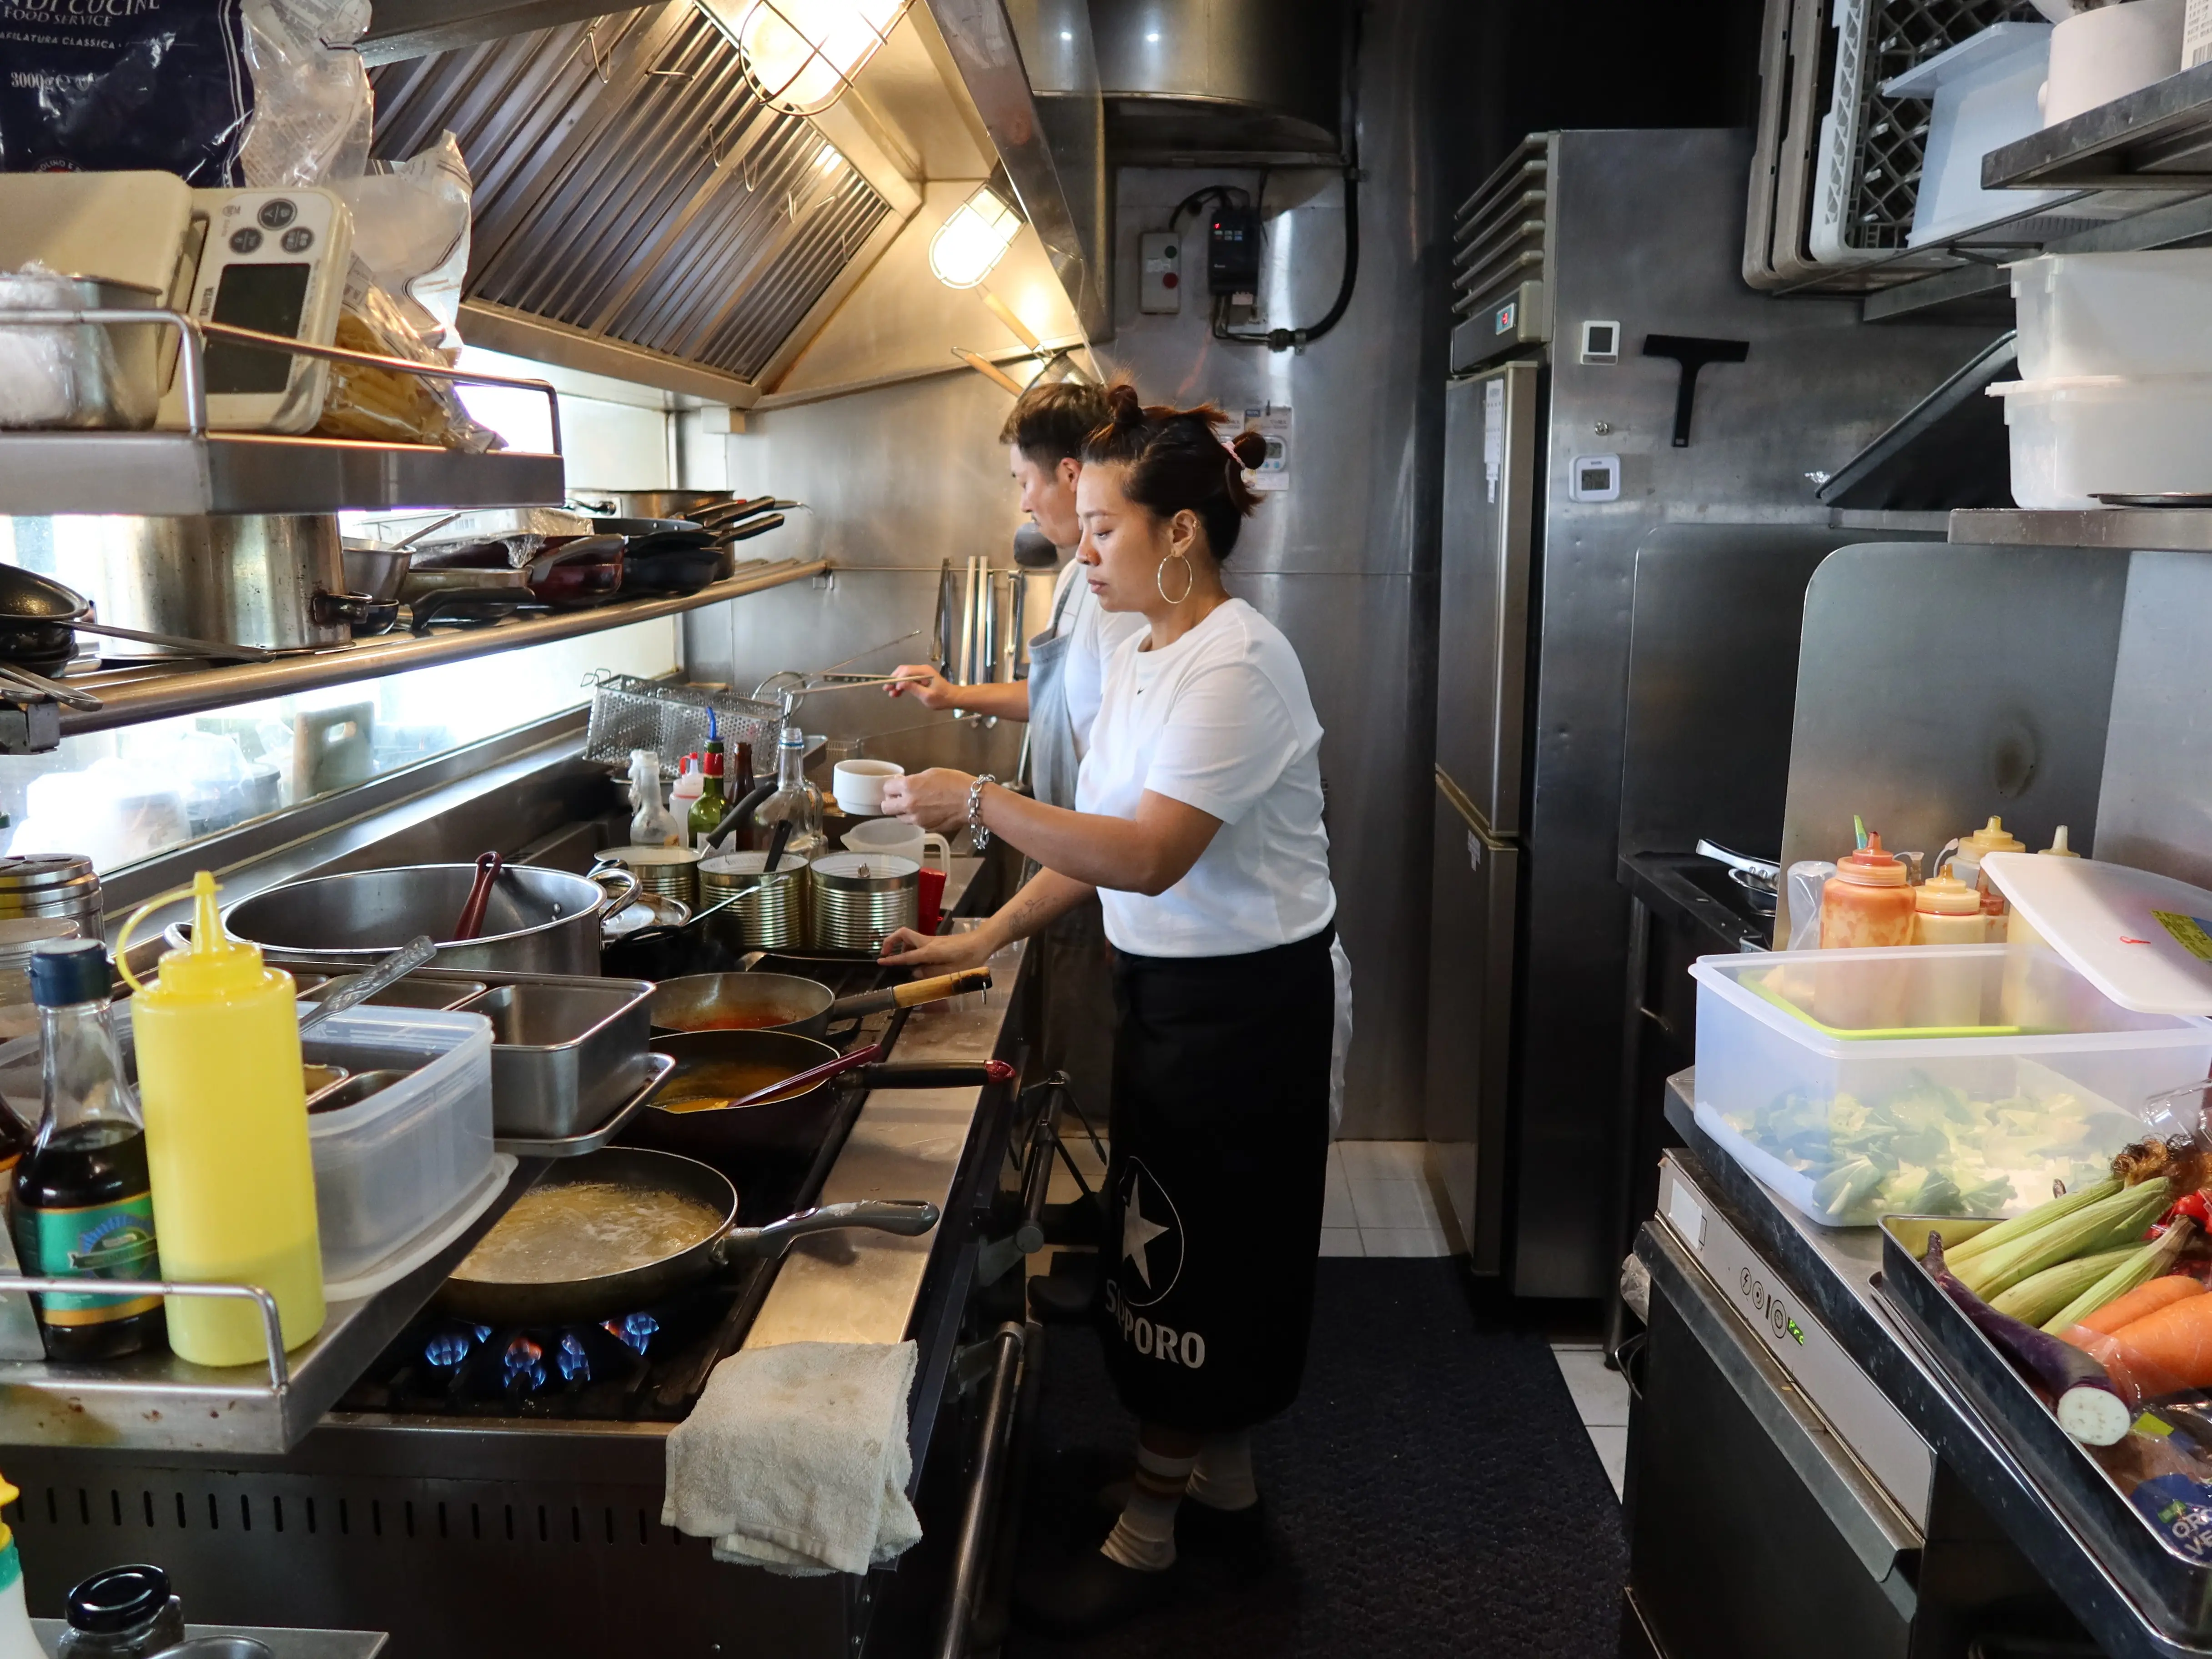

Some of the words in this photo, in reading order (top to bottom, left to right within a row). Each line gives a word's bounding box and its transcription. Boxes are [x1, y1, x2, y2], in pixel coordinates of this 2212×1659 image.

[4, 5, 50, 22] FOOD
[53, 14, 113, 27] SERVICE
[62, 36, 115, 50] CLASSICA
[38, 160, 66, 171] OLINO
[1106, 1279, 1205, 1368] SPPORO
